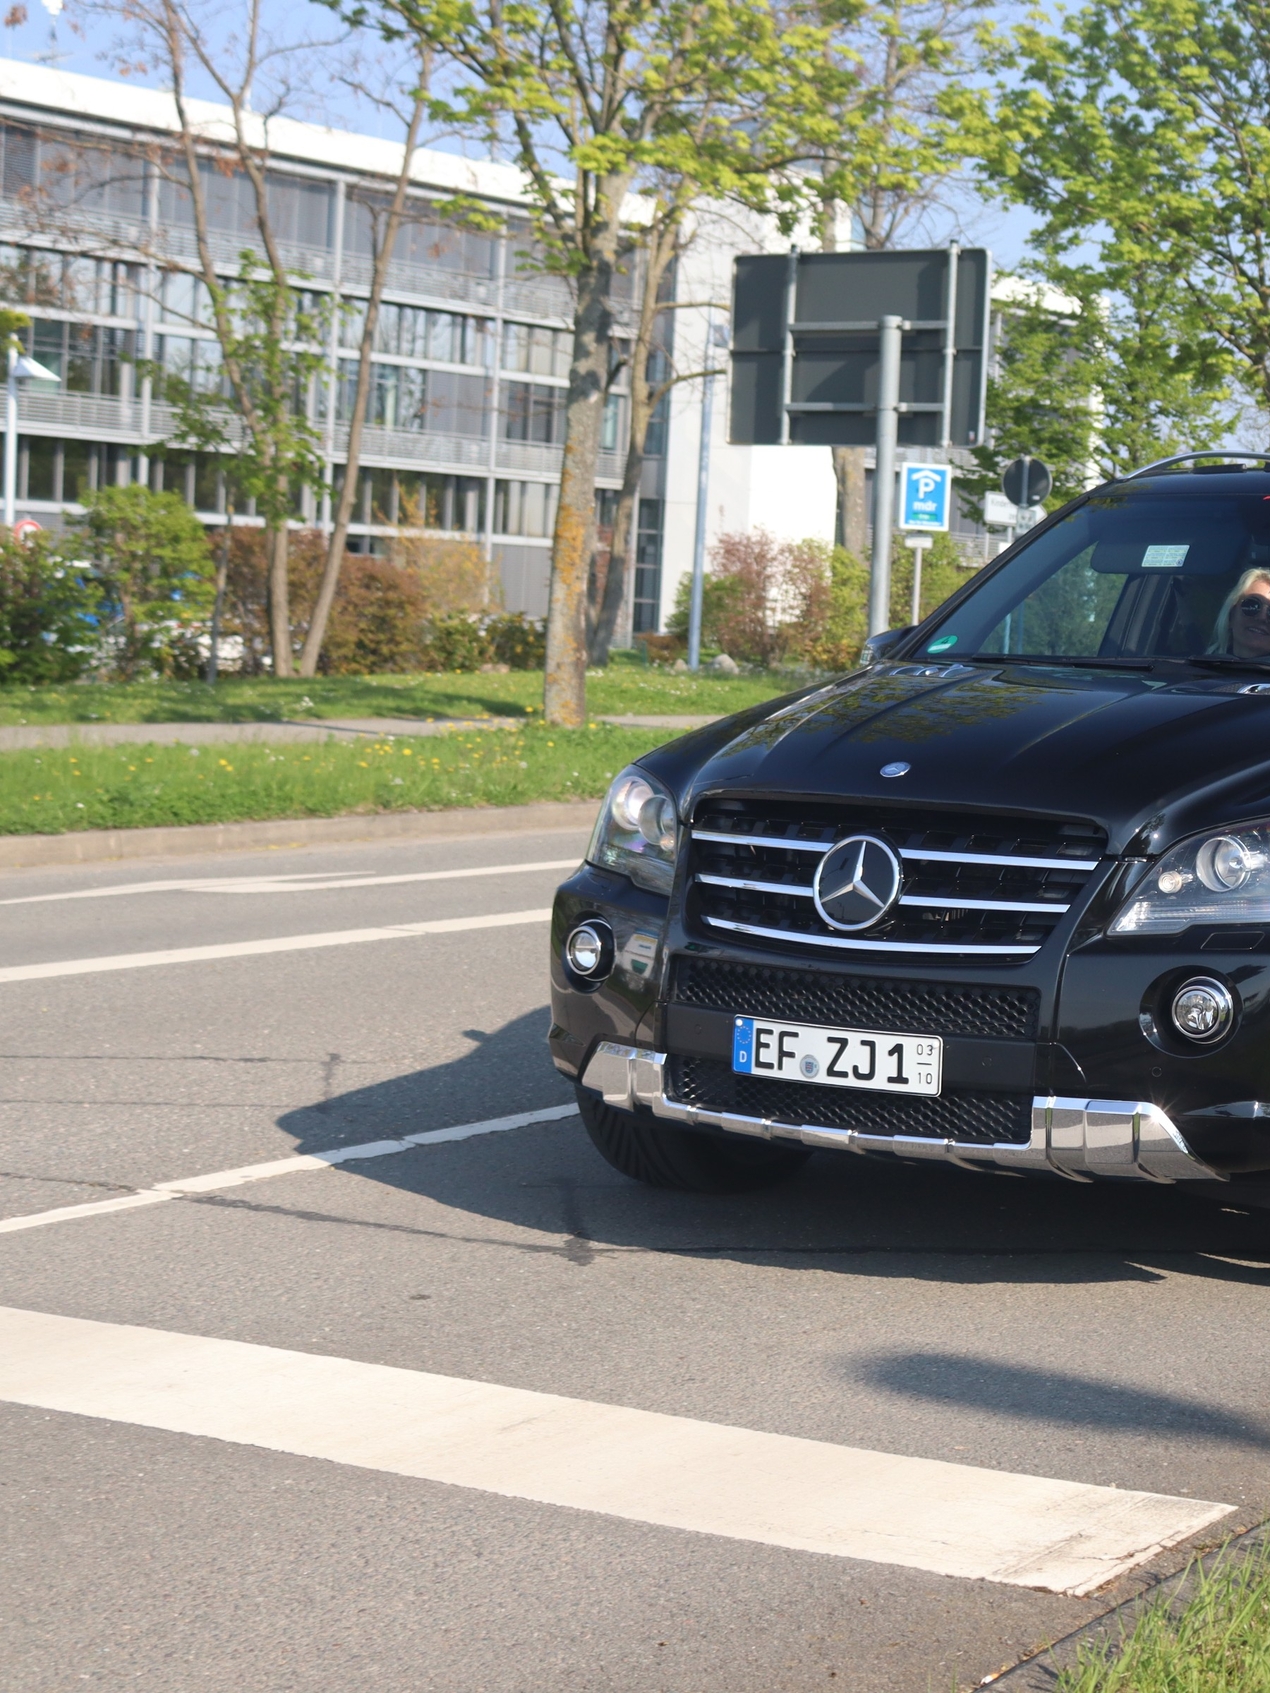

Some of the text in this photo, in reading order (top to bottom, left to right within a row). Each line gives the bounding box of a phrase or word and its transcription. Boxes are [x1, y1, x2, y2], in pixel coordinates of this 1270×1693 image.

[918, 478, 935, 499] P
[912, 501, 938, 511] mdr
[754, 1027, 799, 1071] EF
[916, 1043, 933, 1056] 03
[738, 1051, 748, 1063] D
[917, 1072, 933, 1085] 10
